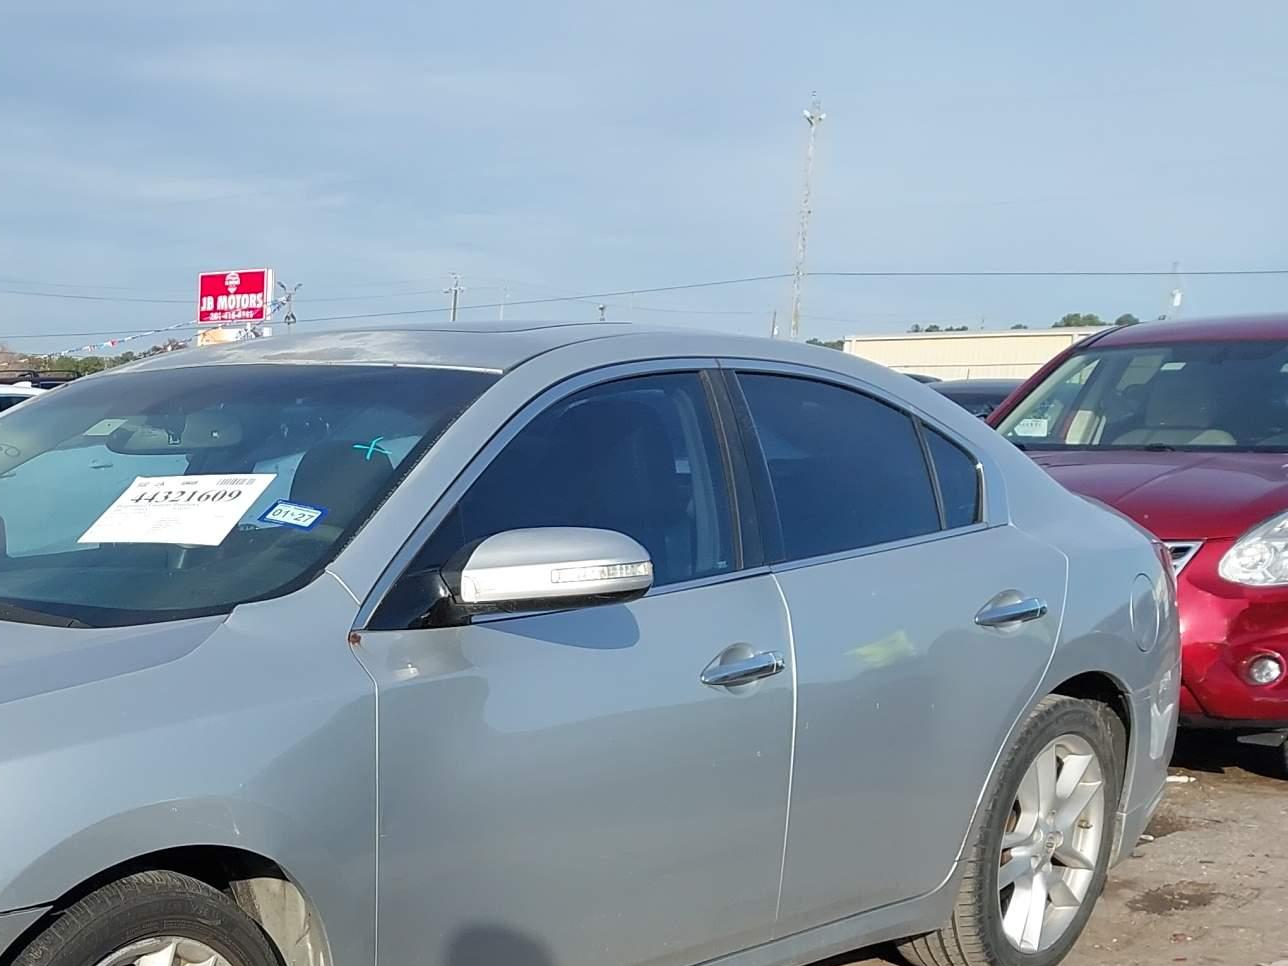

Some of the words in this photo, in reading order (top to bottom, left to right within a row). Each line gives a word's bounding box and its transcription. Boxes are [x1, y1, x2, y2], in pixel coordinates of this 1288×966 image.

[201, 296, 215, 312] JB
[216, 292, 264, 311] MOTORS
[130, 489, 243, 504] 44321609
